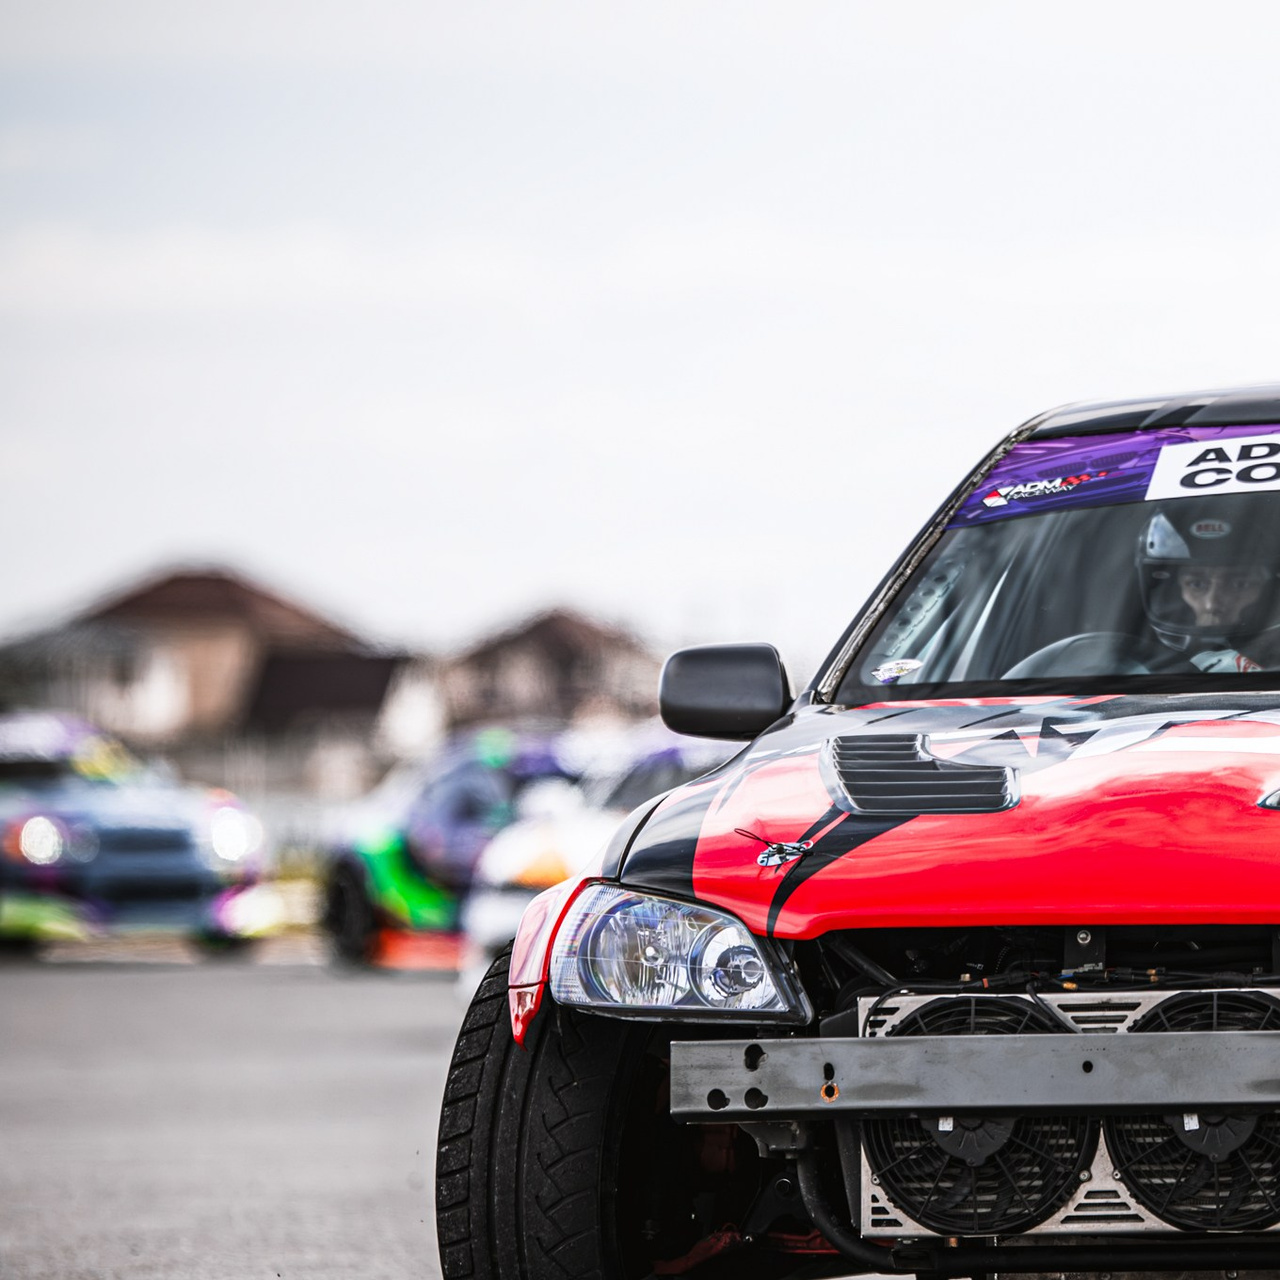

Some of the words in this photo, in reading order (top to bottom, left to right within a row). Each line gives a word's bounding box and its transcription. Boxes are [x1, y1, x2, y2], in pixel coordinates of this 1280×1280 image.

[1006, 484, 1078, 500] RACEWAY
[1010, 477, 1063, 496] ADM
[1195, 523, 1225, 533] BELL
